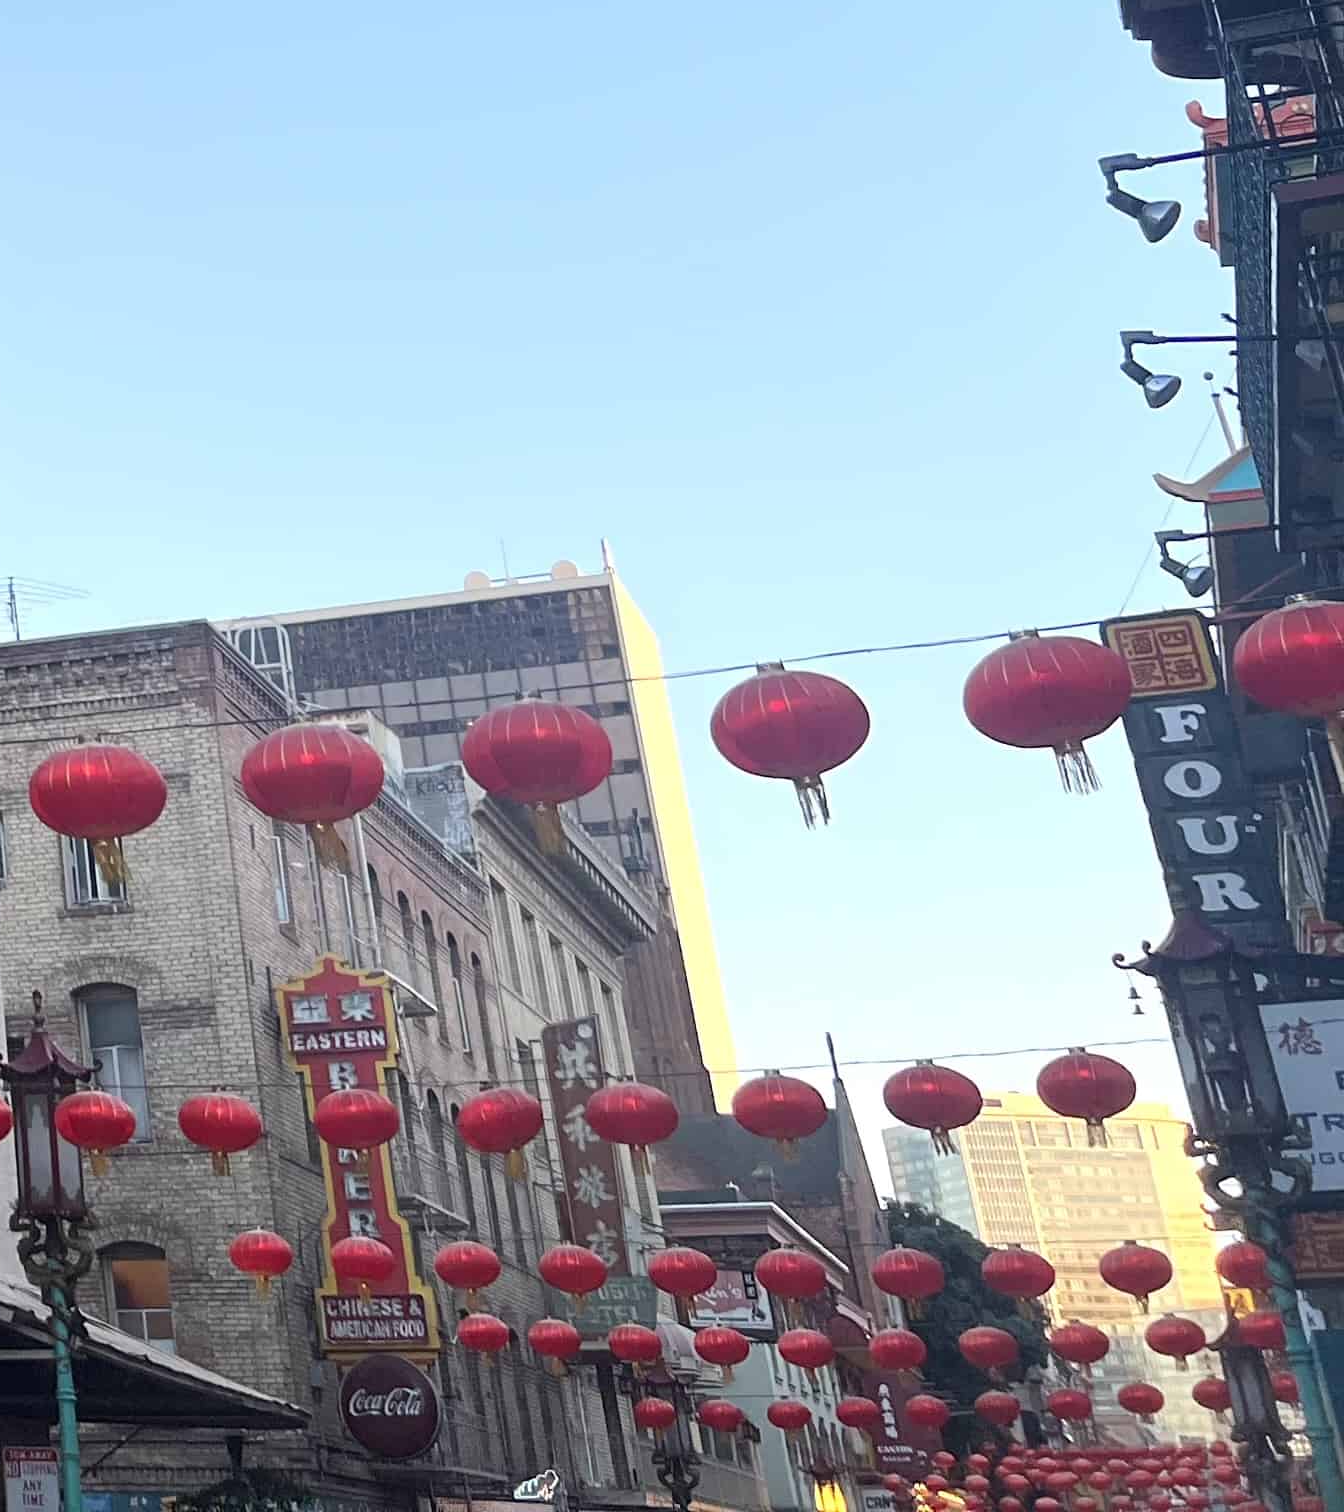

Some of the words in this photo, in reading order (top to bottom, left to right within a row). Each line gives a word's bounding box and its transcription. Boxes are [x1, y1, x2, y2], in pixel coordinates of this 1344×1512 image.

[1154, 703, 1262, 913] FOUR
[292, 1029, 386, 1051] EASTERN
[326, 1297, 403, 1317] CHINESE
[409, 1297, 422, 1316] &
[331, 1320, 390, 1337] AMERICAN
[392, 1319, 425, 1337] FOOD
[23, 1479, 42, 1491] ANY
[22, 1493, 44, 1506] TIME
